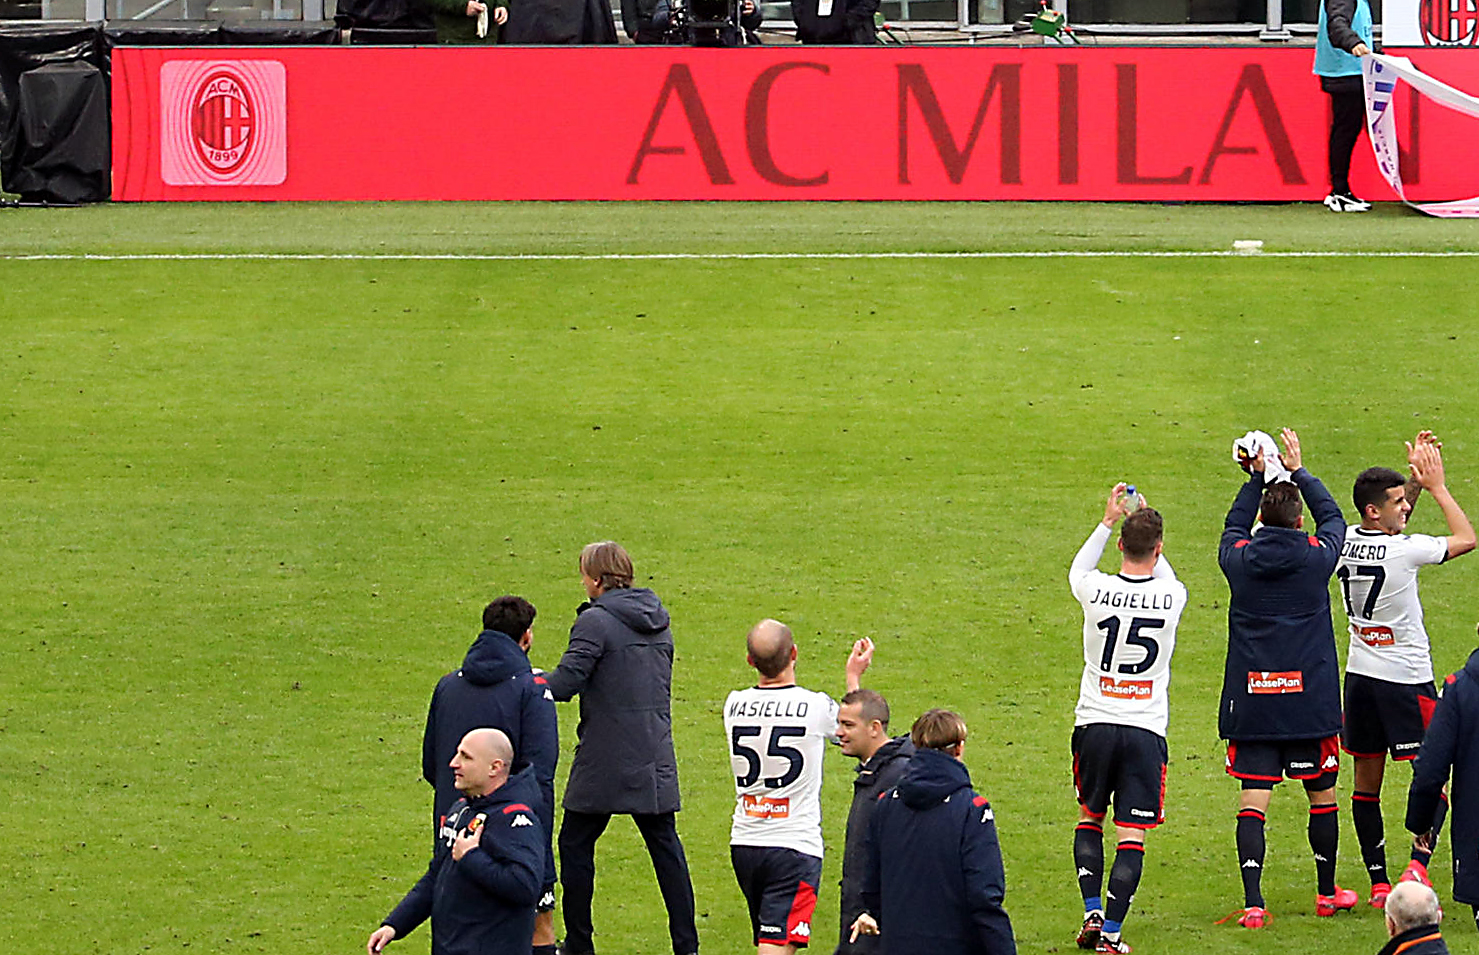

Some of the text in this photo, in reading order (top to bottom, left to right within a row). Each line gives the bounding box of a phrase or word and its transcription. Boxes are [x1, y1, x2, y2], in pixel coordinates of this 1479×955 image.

[205, 79, 241, 98] ACM
[625, 61, 830, 187] AC
[209, 150, 239, 162] 1899
[1340, 541, 1387, 560] OMERO
[1090, 589, 1173, 610] JAGIELLO
[1336, 564, 1386, 621] 17
[1096, 615, 1165, 675] 15
[1101, 680, 1151, 695] LeasePlan
[1249, 676, 1301, 688] LeasePlan
[729, 701, 808, 718] MASIELLO
[731, 725, 806, 789] 55
